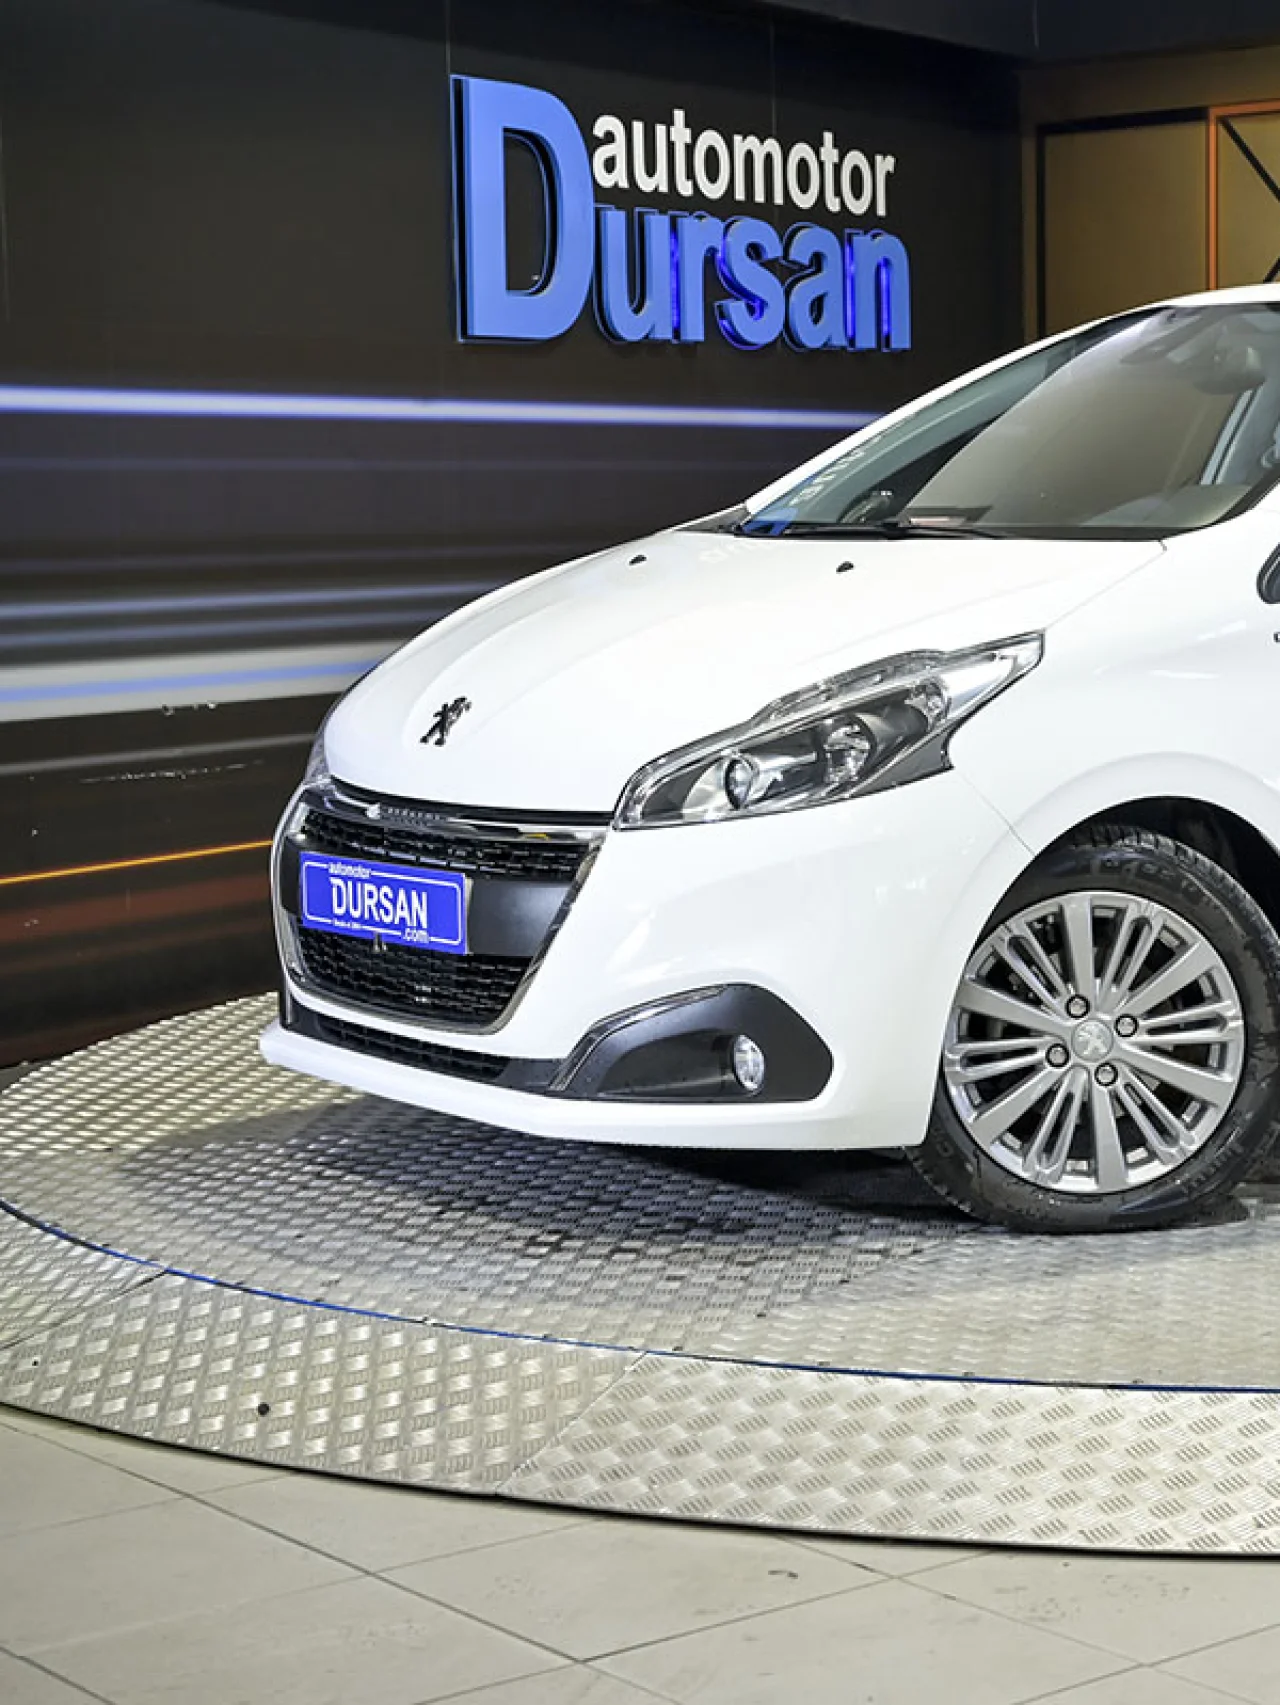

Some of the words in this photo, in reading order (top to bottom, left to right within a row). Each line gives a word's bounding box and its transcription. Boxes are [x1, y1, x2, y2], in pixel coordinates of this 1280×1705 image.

[450, 74, 911, 352] Dursan
[592, 108, 896, 217] automotor
[330, 878, 428, 928] DURSAN
